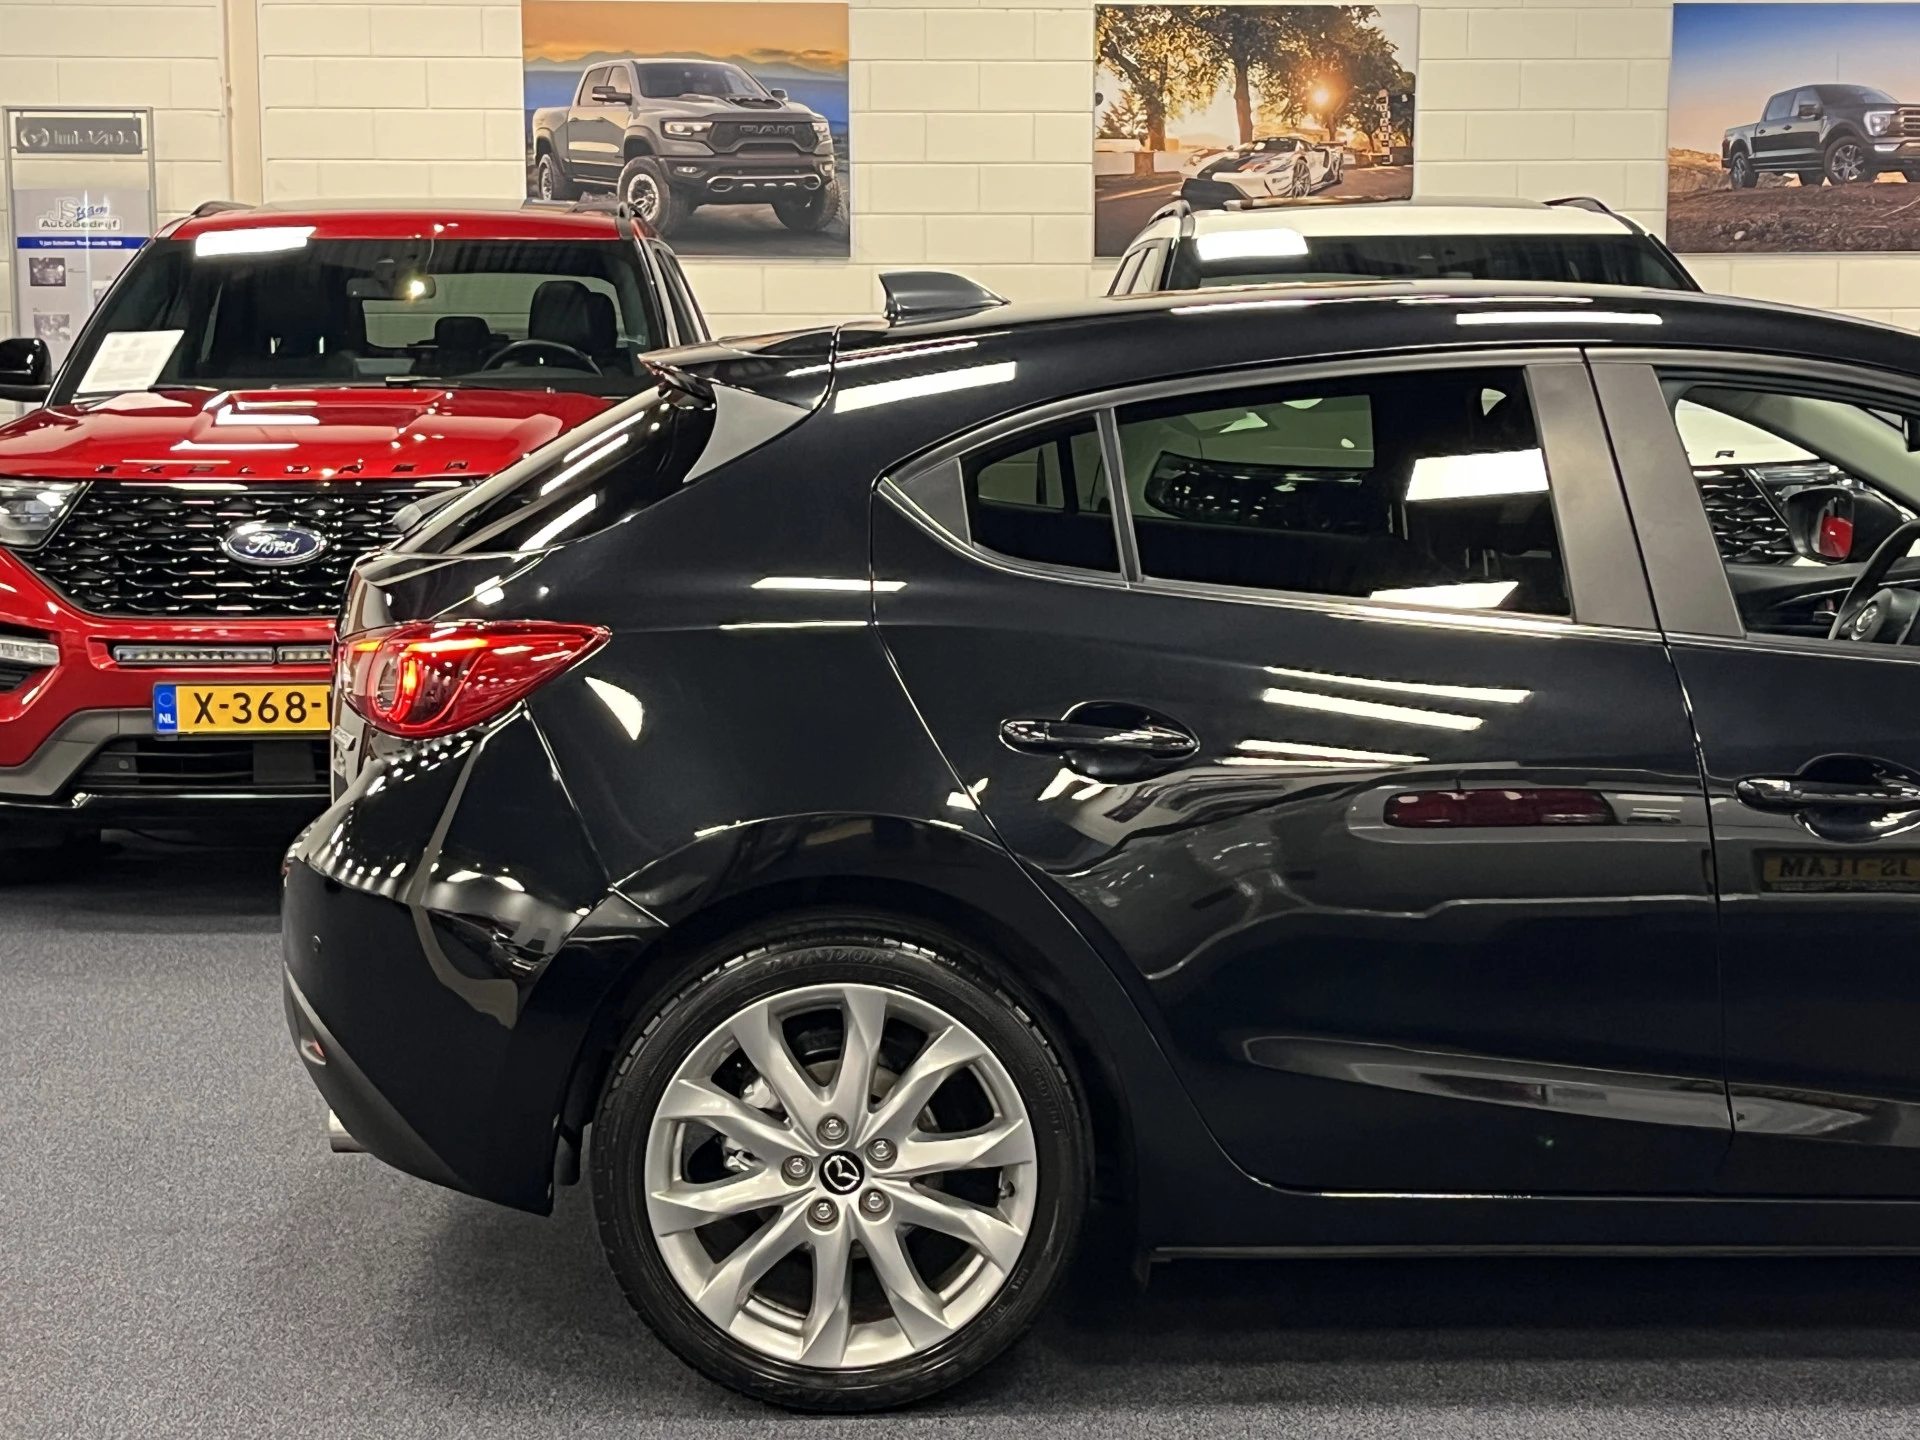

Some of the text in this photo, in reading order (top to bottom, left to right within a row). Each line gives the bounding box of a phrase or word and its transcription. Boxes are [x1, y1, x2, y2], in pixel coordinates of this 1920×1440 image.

[740, 124, 796, 135] RAM
[41, 220, 117, 230] Autobedrijf
[94, 460, 468, 475] EXPLORER
[245, 532, 300, 554] Ford
[158, 712, 176, 724] NL
